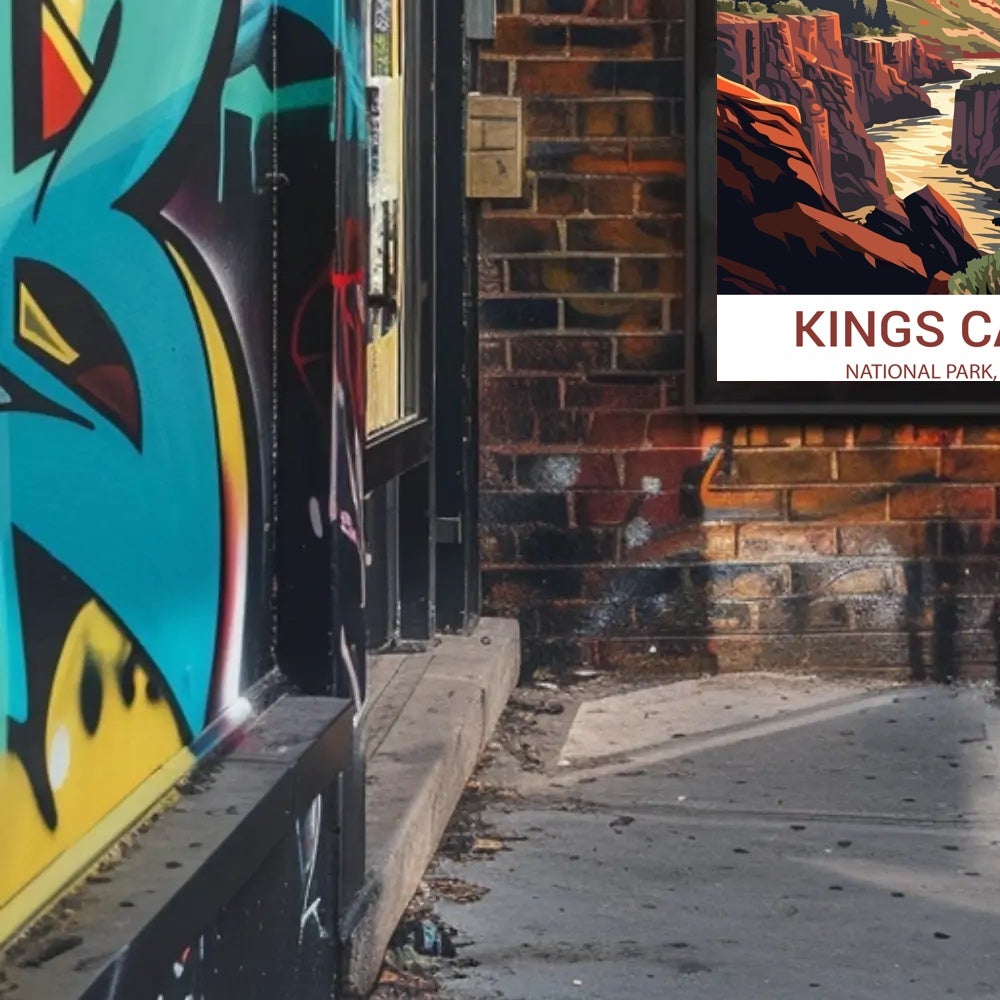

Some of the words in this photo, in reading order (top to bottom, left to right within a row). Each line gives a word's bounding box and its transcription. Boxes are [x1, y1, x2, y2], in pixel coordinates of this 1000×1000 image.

[795, 310, 945, 348] KINGS
[846, 363, 941, 380] NATIONAL
[946, 363, 998, 381] PARK,
